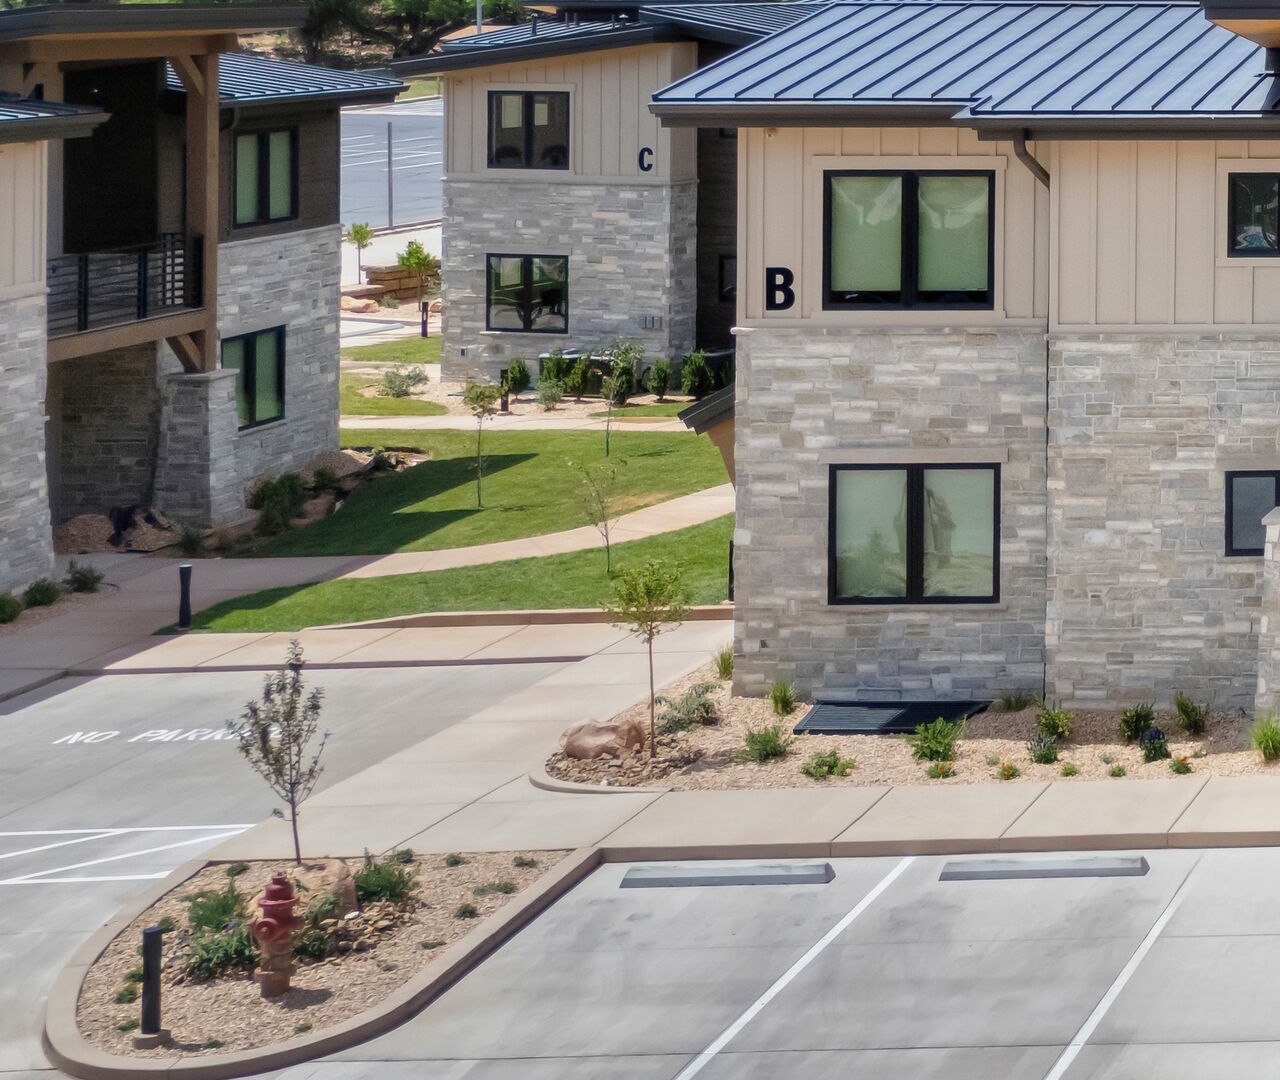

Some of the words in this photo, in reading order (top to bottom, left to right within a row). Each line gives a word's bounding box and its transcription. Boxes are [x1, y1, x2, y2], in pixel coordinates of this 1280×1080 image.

[639, 147, 654, 172] C
[765, 267, 796, 311] B
[51, 730, 120, 744] NO
[127, 727, 284, 743] PARKIG
